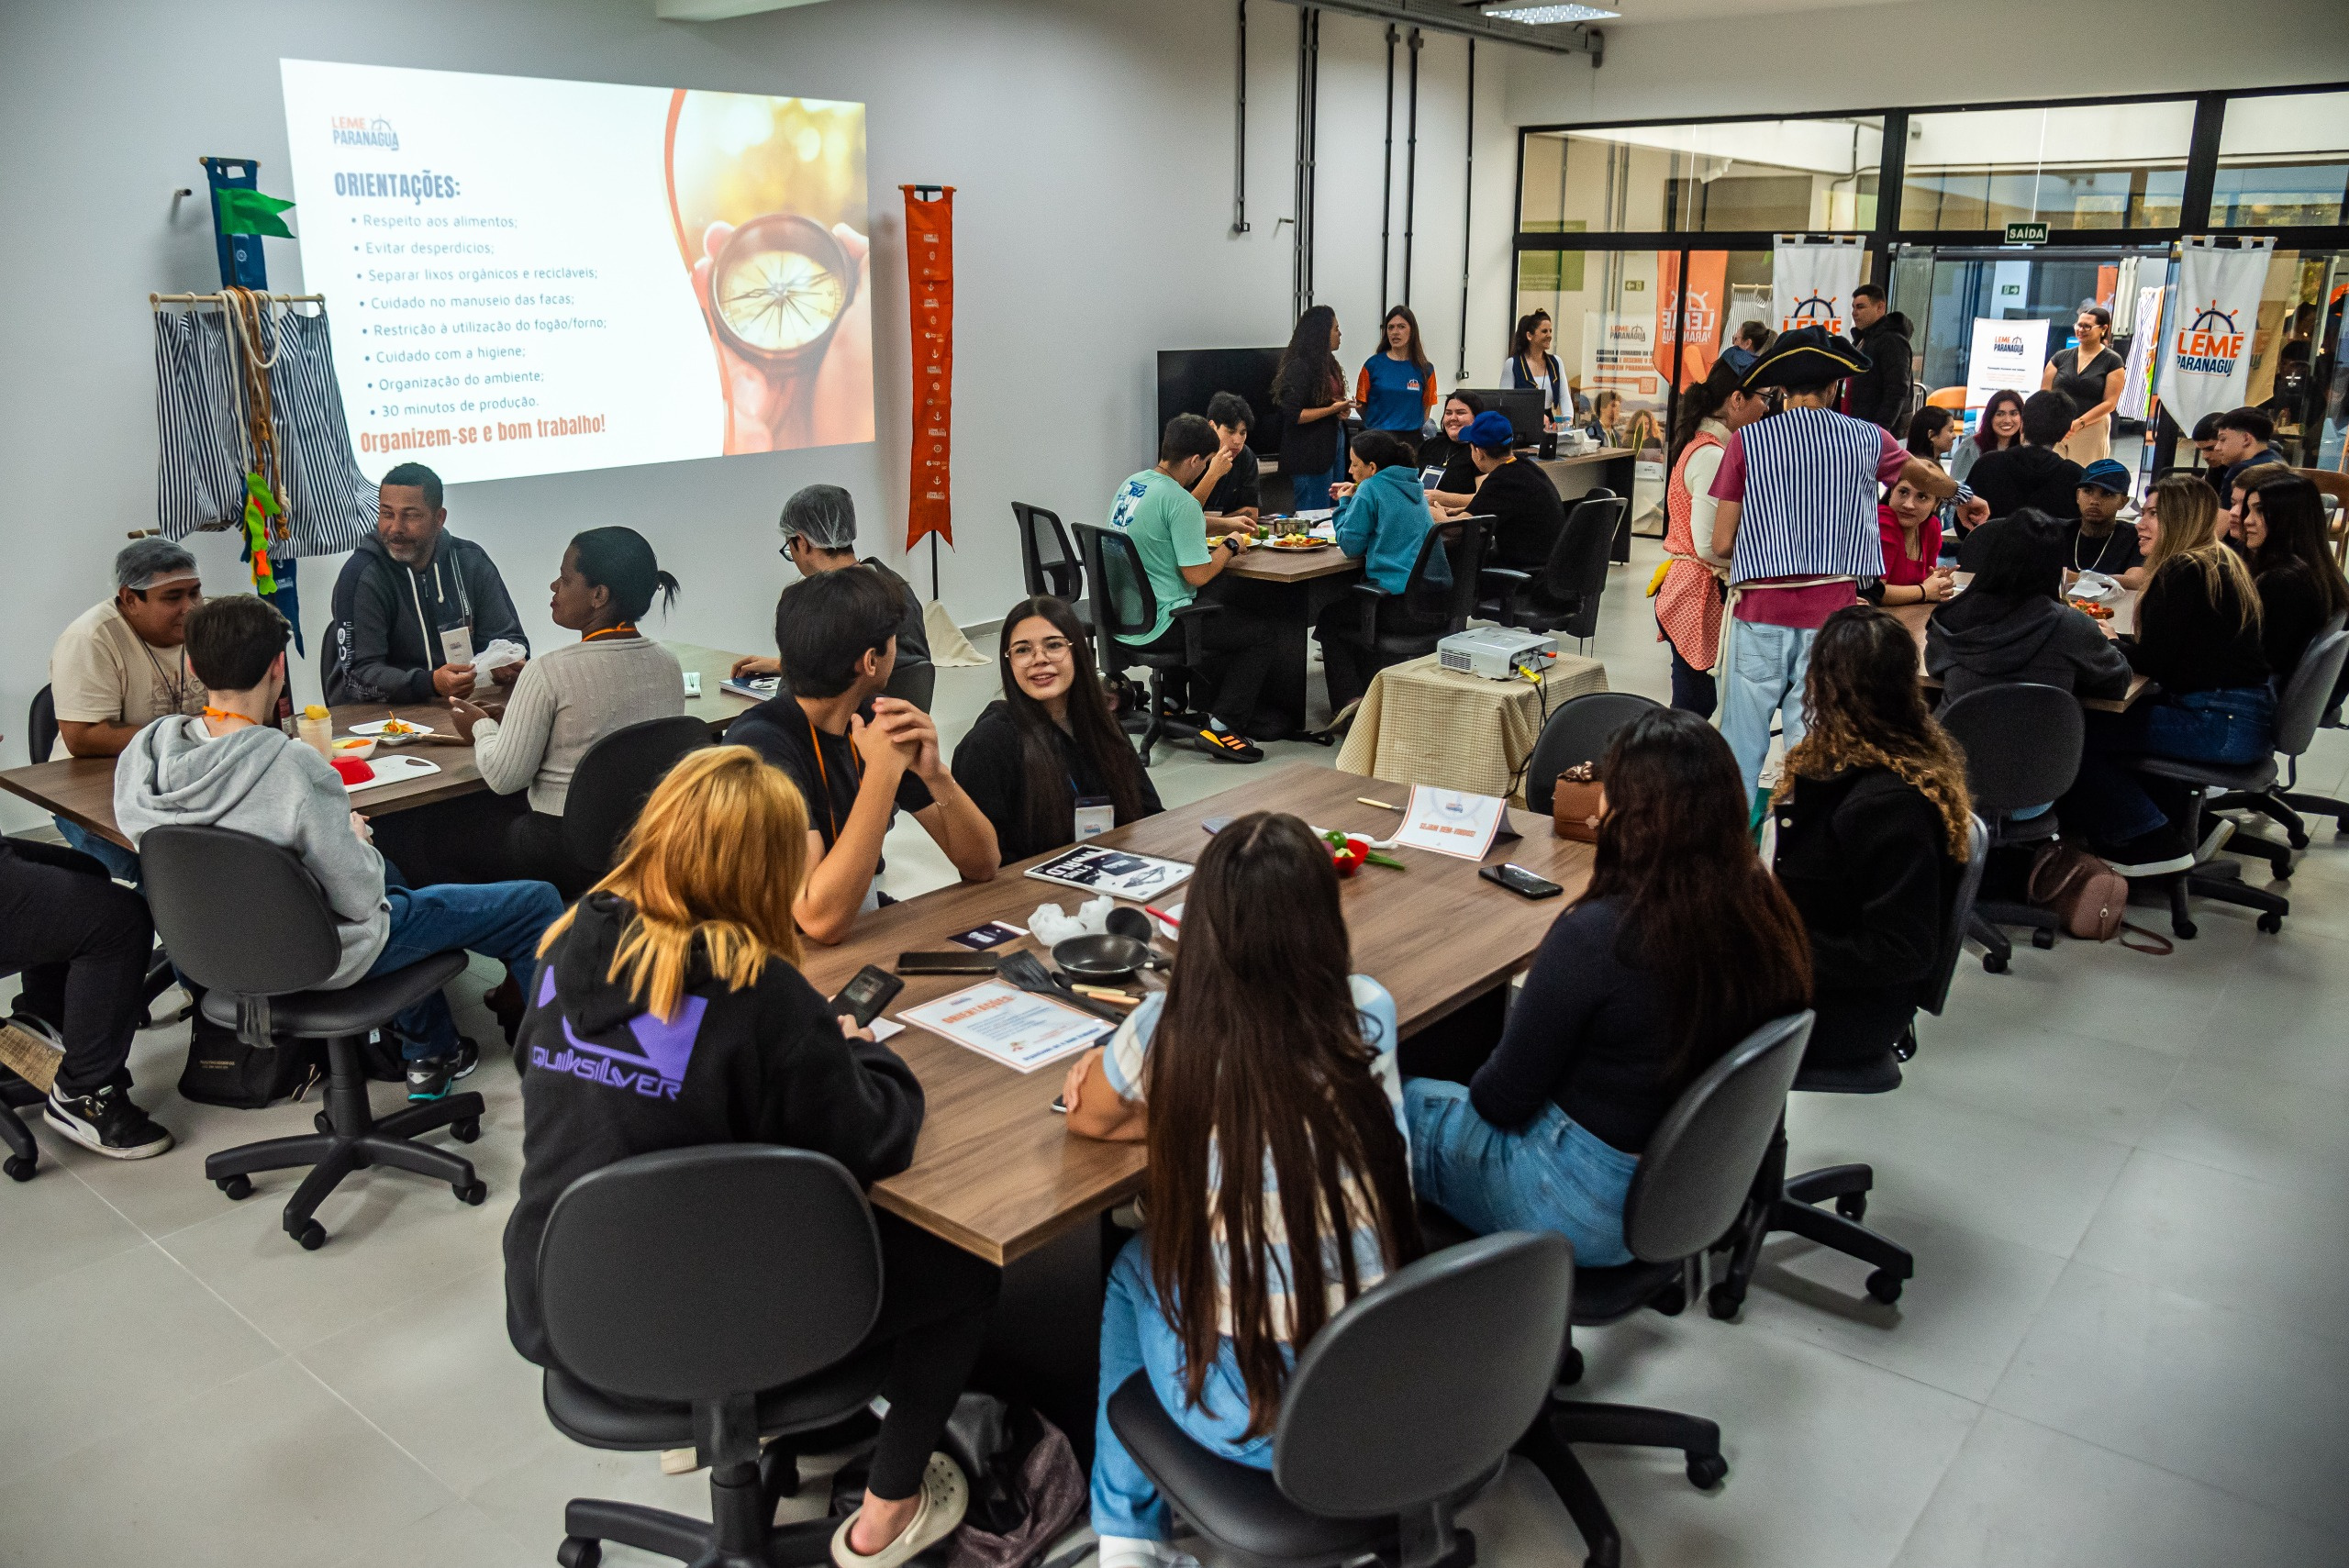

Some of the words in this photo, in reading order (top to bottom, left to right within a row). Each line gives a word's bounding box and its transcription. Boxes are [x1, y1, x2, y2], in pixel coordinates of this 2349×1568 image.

[331, 116, 366, 130] LEME
[334, 170, 461, 206] ORIENTAÇÕES:
[363, 215, 421, 229] Respeito
[426, 217, 449, 228] aos
[453, 215, 518, 228] alimentos;
[2009, 226, 2043, 239] SAÍDA
[366, 242, 406, 254] Evitar
[369, 269, 419, 284] Separar
[425, 268, 454, 281] lixos
[459, 267, 518, 283] orgânicos
[523, 270, 529, 279] e
[534, 266, 597, 279] recicláveis;
[371, 296, 426, 310] Cuidado
[430, 298, 446, 307] no
[451, 295, 511, 307] manuseio
[515, 295, 536, 306] das
[540, 294, 574, 306] facas;
[374, 323, 436, 338] Restrição
[452, 320, 511, 335] utilização
[516, 320, 530, 331] do
[535, 317, 607, 333] fogão/forno;
[1610, 325, 1630, 333] LEME
[1994, 336, 2011, 344] LEME
[2177, 331, 2244, 359] LEME
[376, 350, 430, 364] Cuidado
[435, 350, 462, 361] com
[466, 350, 473, 360] a
[478, 346, 526, 361] higiene;
[379, 374, 460, 393] Organização
[464, 373, 480, 385] do
[484, 371, 544, 385] ambiente;
[382, 405, 399, 417] 30
[404, 402, 456, 416] minutos
[461, 399, 475, 412] de
[480, 396, 539, 413] produção.
[361, 423, 477, 454] Organizem-se
[483, 425, 492, 442] e
[497, 420, 532, 442] bom
[537, 414, 606, 439] trabalho!
